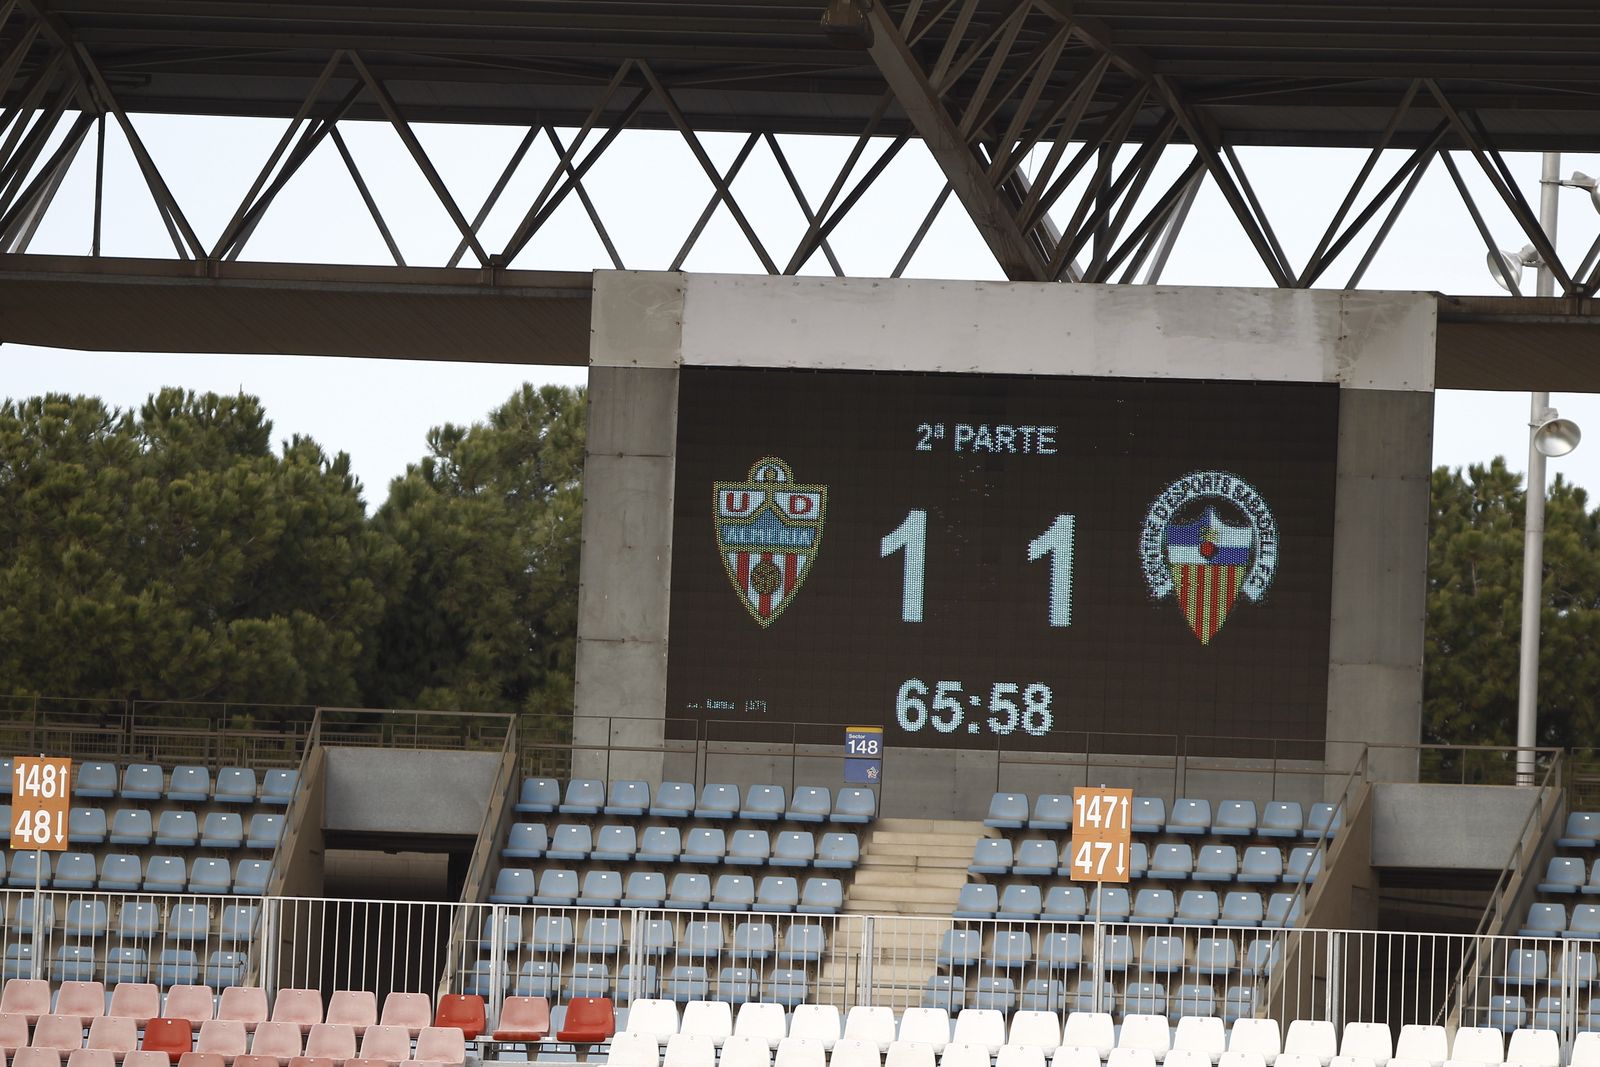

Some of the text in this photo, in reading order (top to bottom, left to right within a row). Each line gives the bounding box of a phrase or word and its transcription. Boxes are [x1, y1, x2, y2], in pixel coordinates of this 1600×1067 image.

[954, 424, 1058, 455] PARTE
[726, 492, 814, 515] U D
[880, 509, 1076, 628] 1 1
[895, 677, 1054, 737] 65:58
[848, 739, 879, 755] 148
[15, 763, 57, 799] 148
[14, 809, 51, 844] 48
[1075, 794, 1118, 829] 147
[1074, 841, 1113, 875] 47
